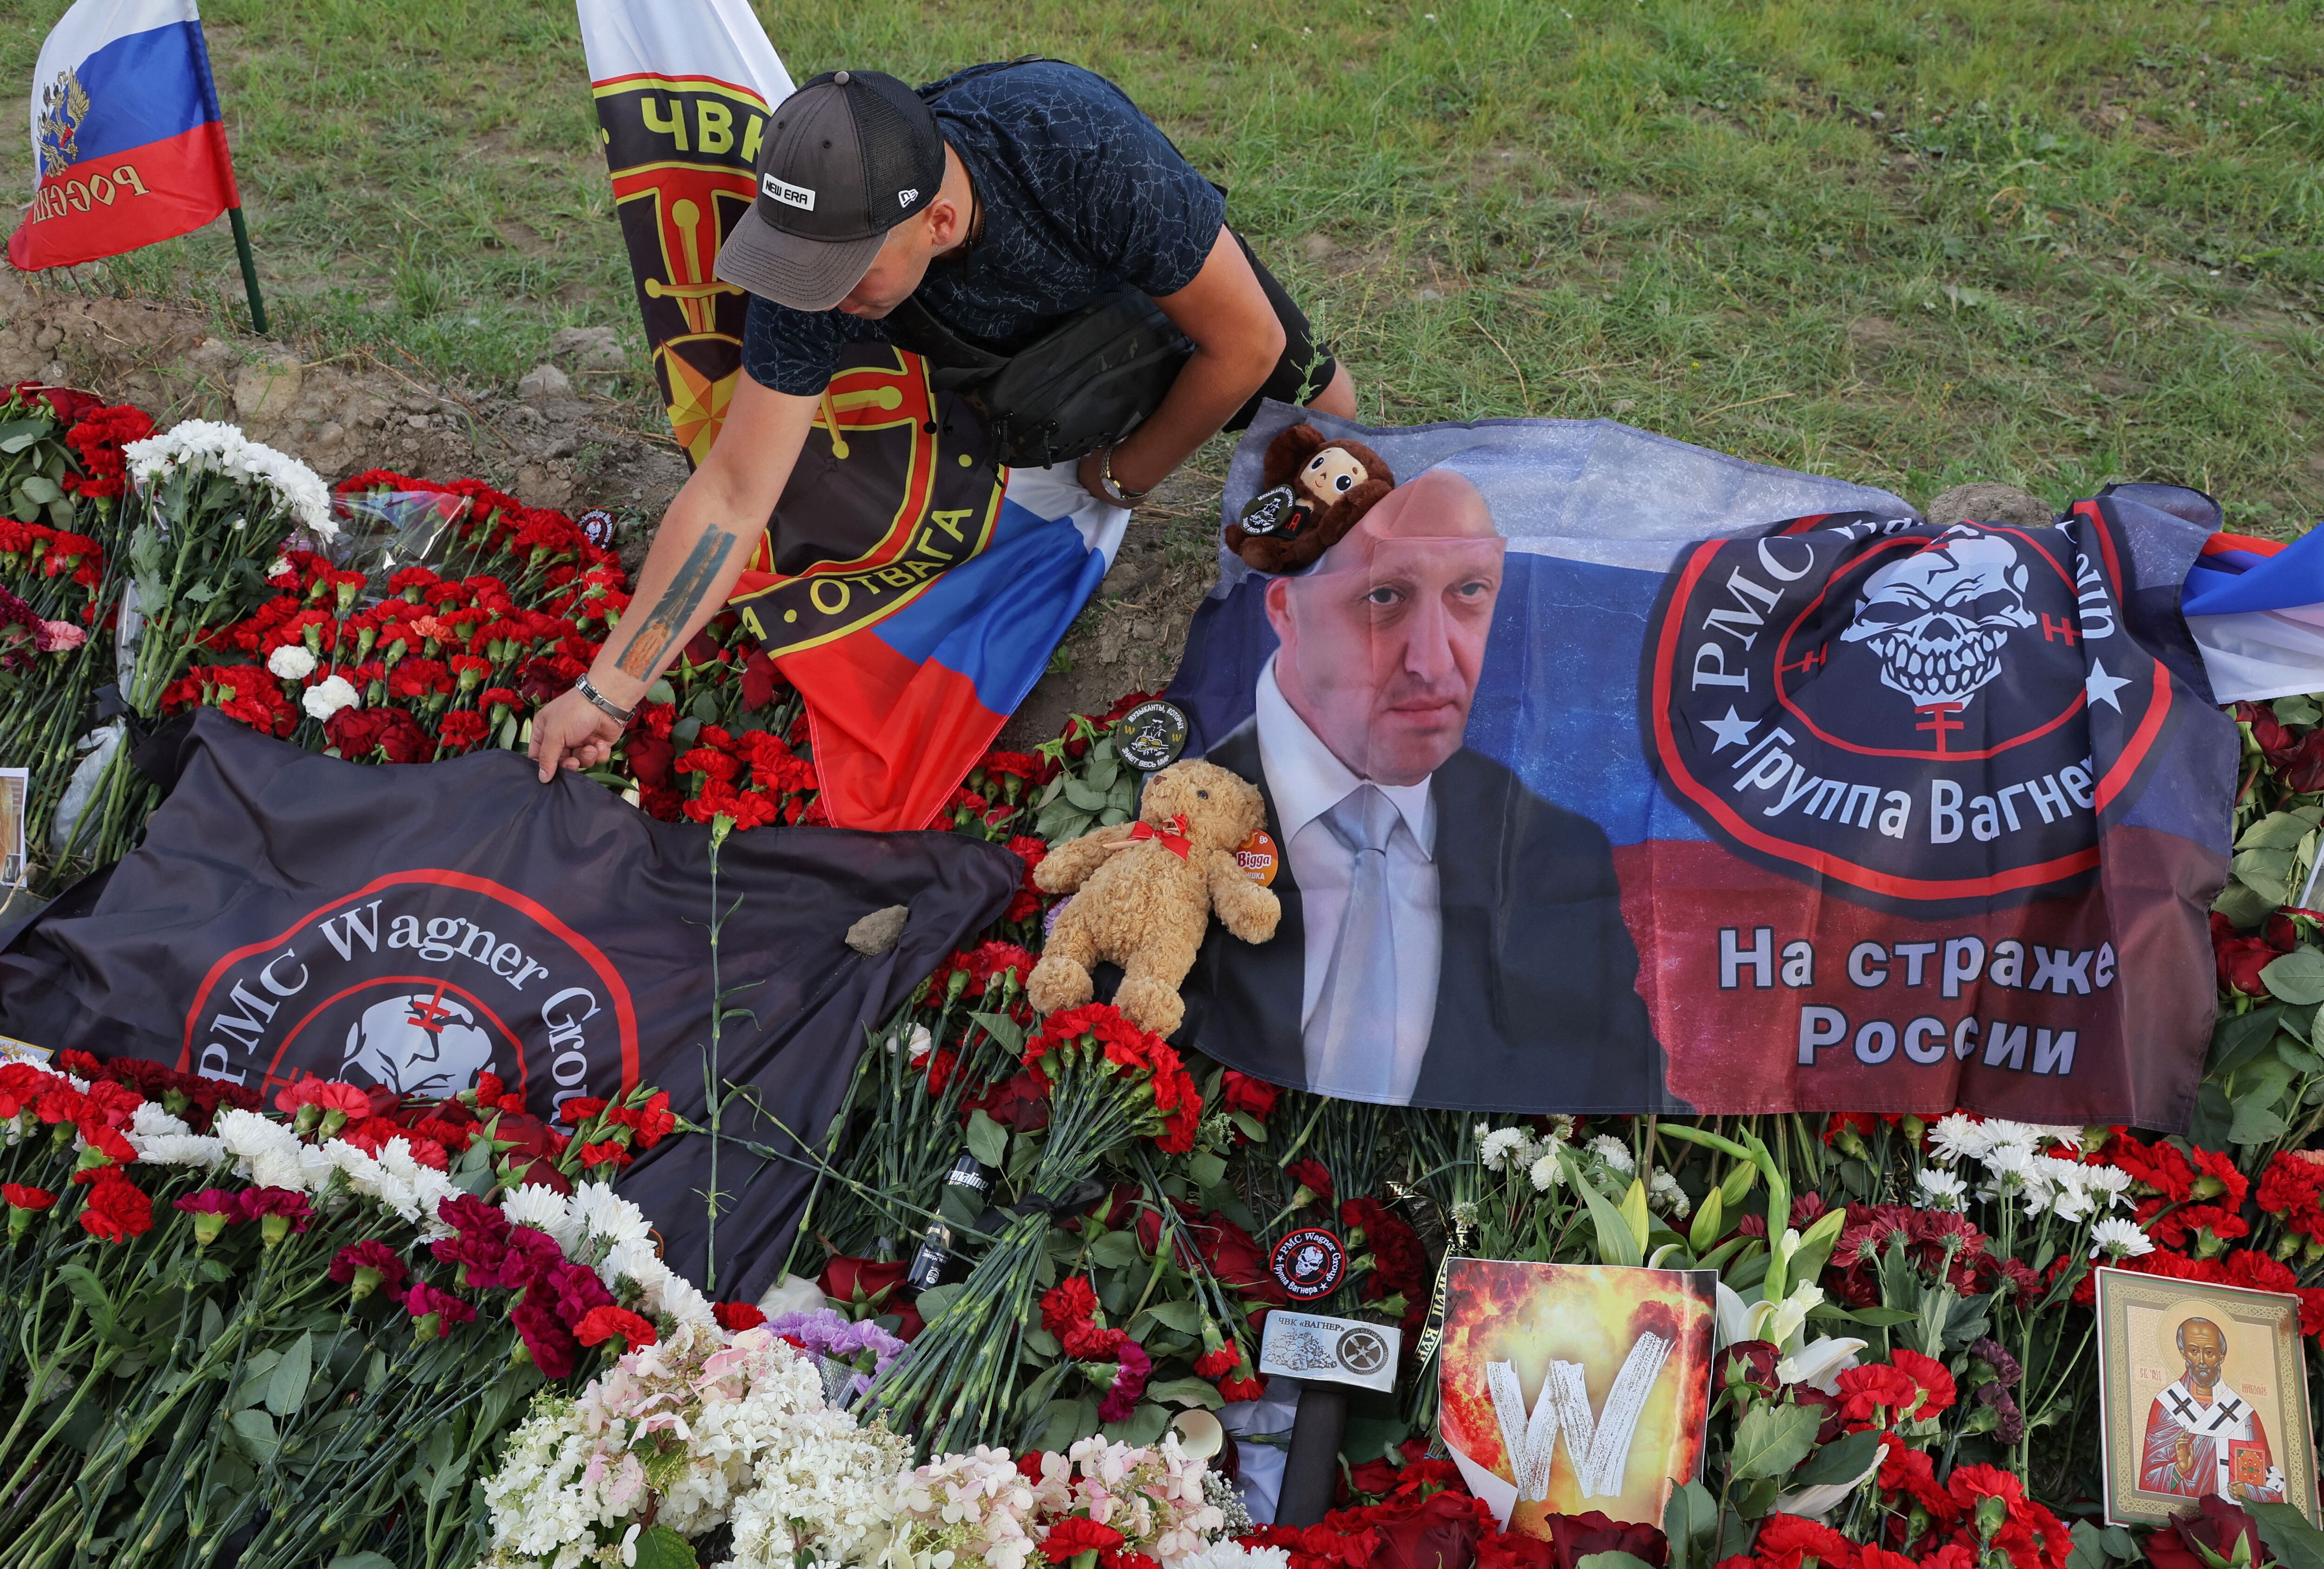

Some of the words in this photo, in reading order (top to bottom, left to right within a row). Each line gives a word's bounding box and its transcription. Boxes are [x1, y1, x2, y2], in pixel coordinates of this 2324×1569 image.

[765, 180, 782, 196] NEW
[784, 190, 808, 205] ERA
[810, 509, 973, 615] ОТВАГА
[1692, 536, 1815, 693] PMC
[1128, 704, 1165, 722] МУЗЫКАНТЫ,
[1167, 707, 1184, 730] КОТОРЫХ
[1122, 747, 1139, 763] ЗНАЕТ
[1157, 755, 1169, 766] МИР
[1731, 726, 1913, 841] Группа
[1237, 852, 1271, 868] Bigga
[1720, 928, 1814, 989] На
[1847, 935, 2115, 998] страже
[198, 947, 310, 1086] PMC
[317, 899, 549, 991] Wagner
[1797, 1005, 2077, 1076] России
[1273, 1264, 1289, 1286] Группа
[1288, 1281, 1318, 1296] Вагнера
[1280, 1234, 1302, 1255] PMC
[1305, 1232, 1336, 1251] Wagner
[1326, 1252, 1341, 1282] Group
[1278, 1317, 1297, 1326] ЧВК
[1299, 1320, 1345, 1332] «ВАГНЕР»
[1361, 1329, 1381, 1340] ВАГНЕР
[1487, 1330, 1676, 1502] W
